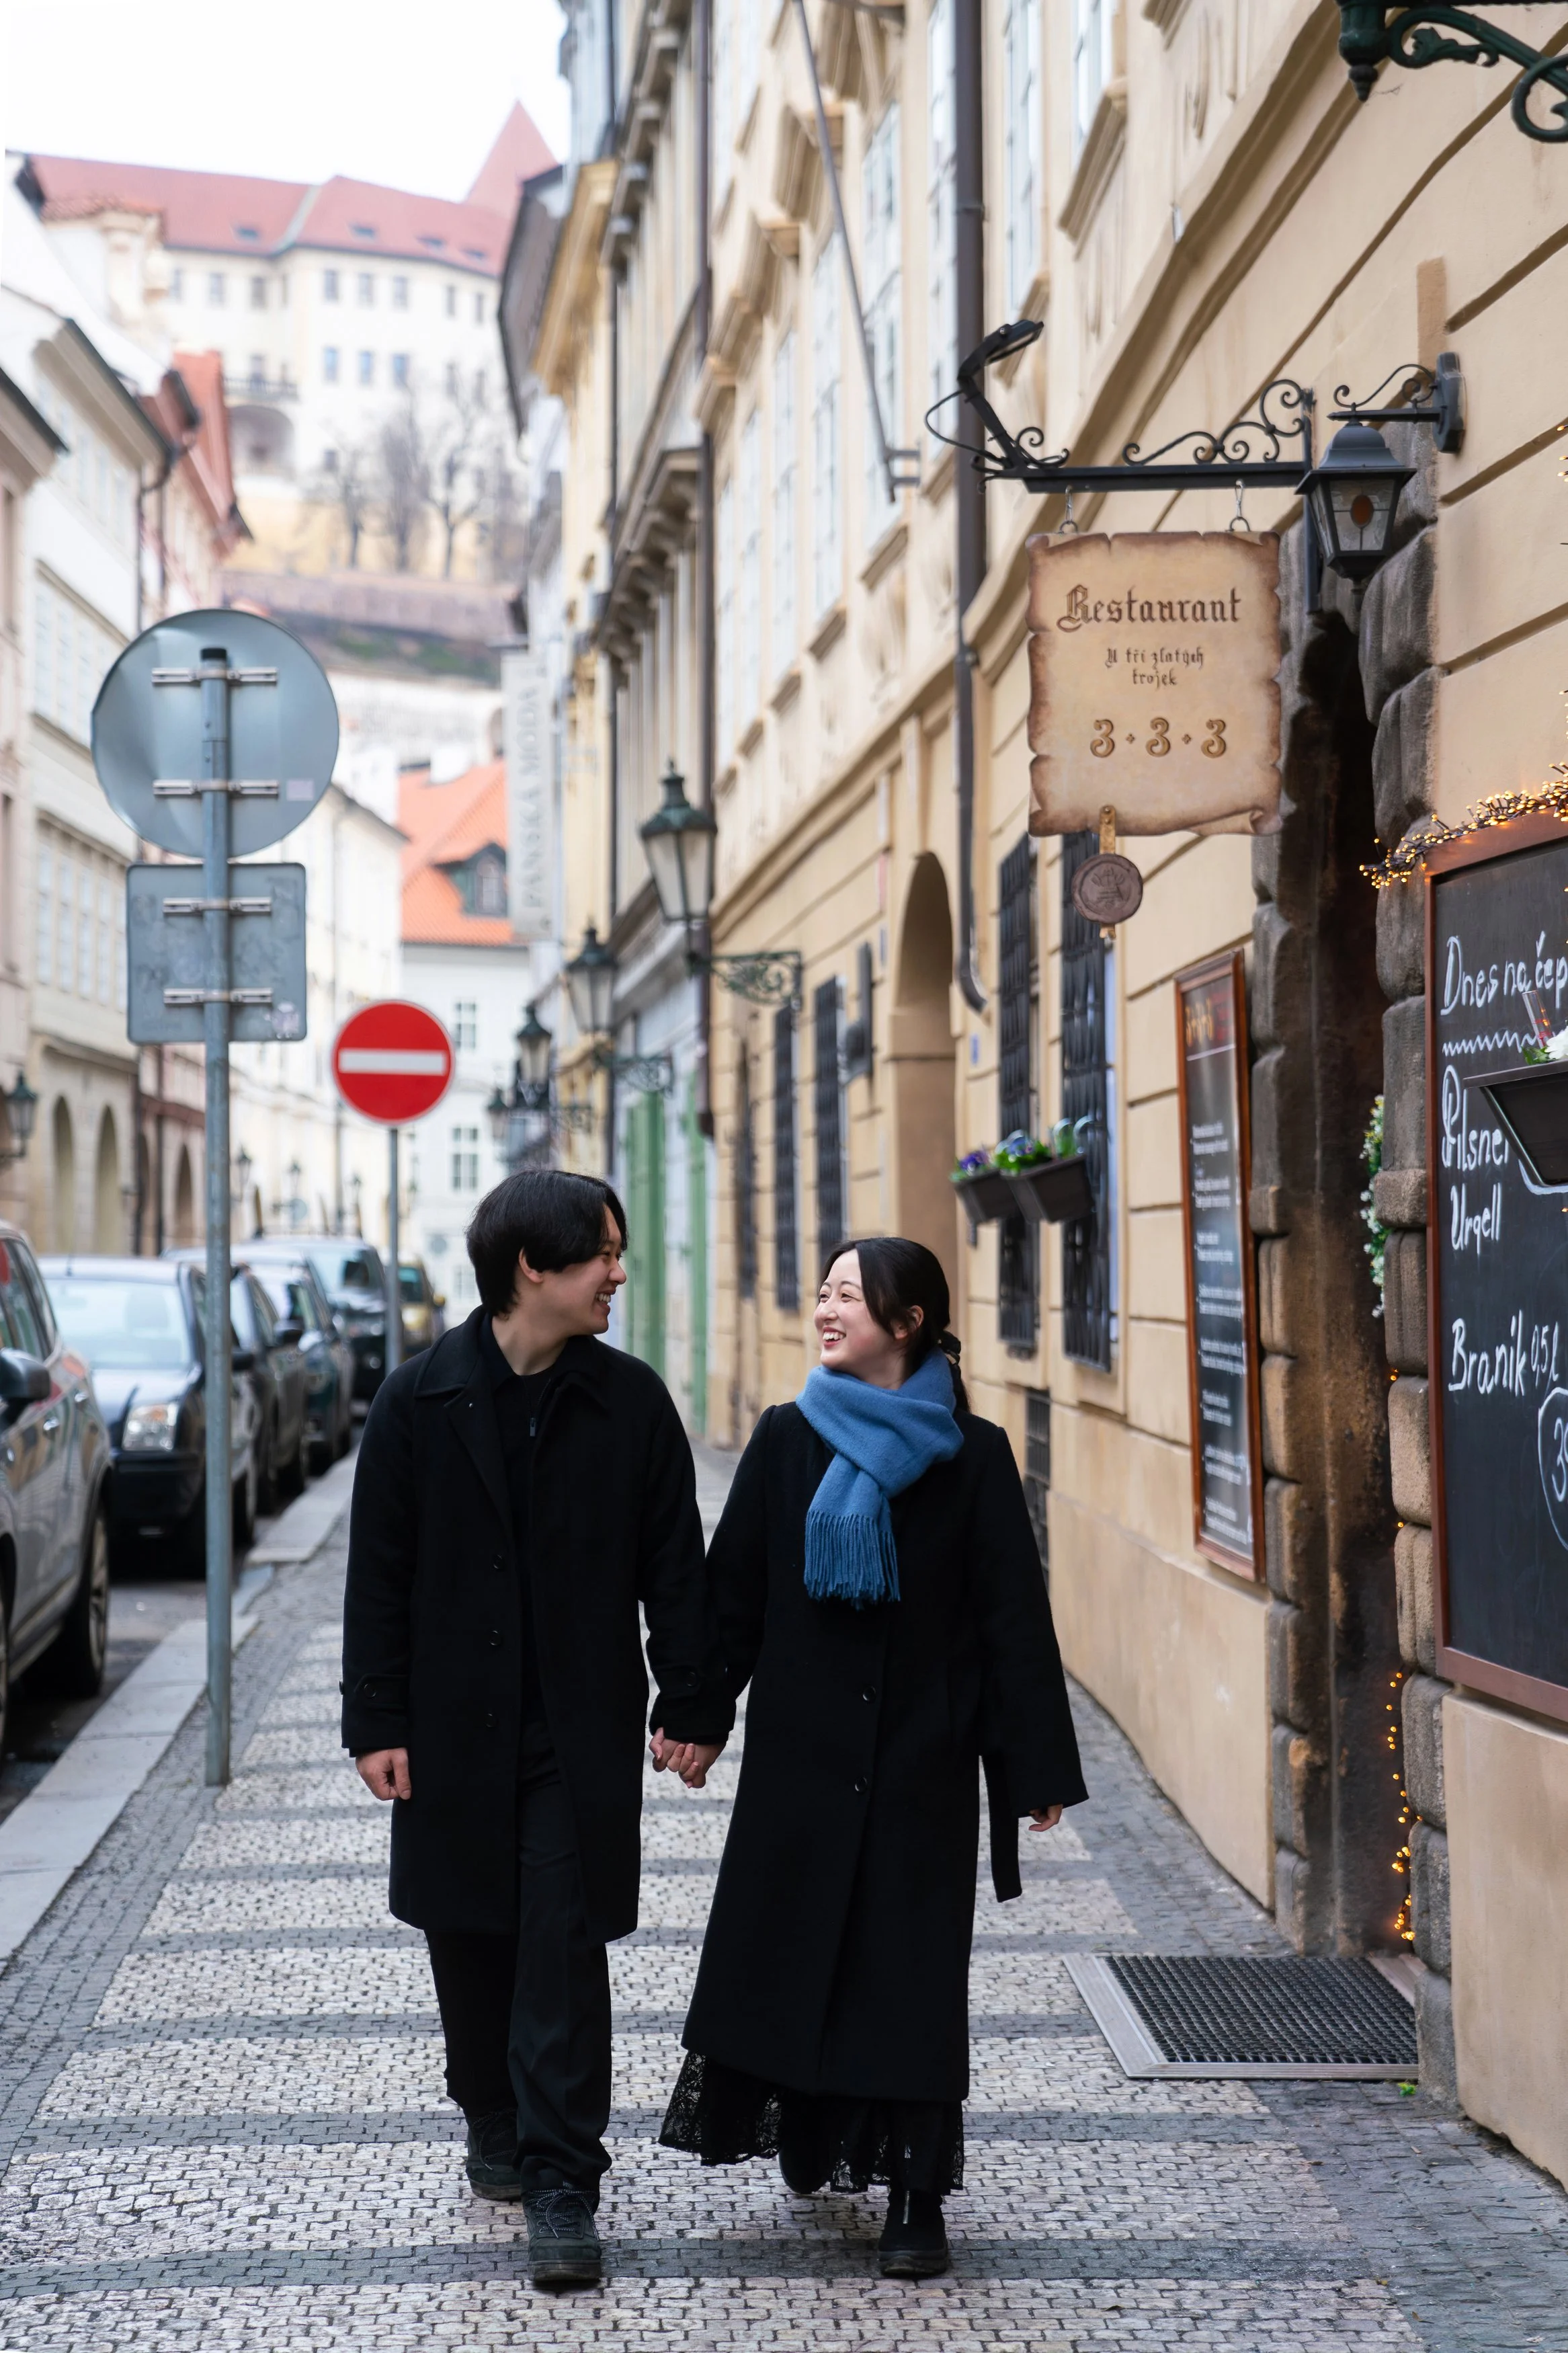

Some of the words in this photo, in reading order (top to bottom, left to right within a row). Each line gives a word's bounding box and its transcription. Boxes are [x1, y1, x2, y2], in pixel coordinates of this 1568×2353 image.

[1057, 584, 1241, 632] Restaurant
[1105, 647, 1118, 668] U
[1132, 668, 1178, 689] trojek
[1440, 935, 1499, 1016] Dnes
[1503, 961, 1531, 996] na
